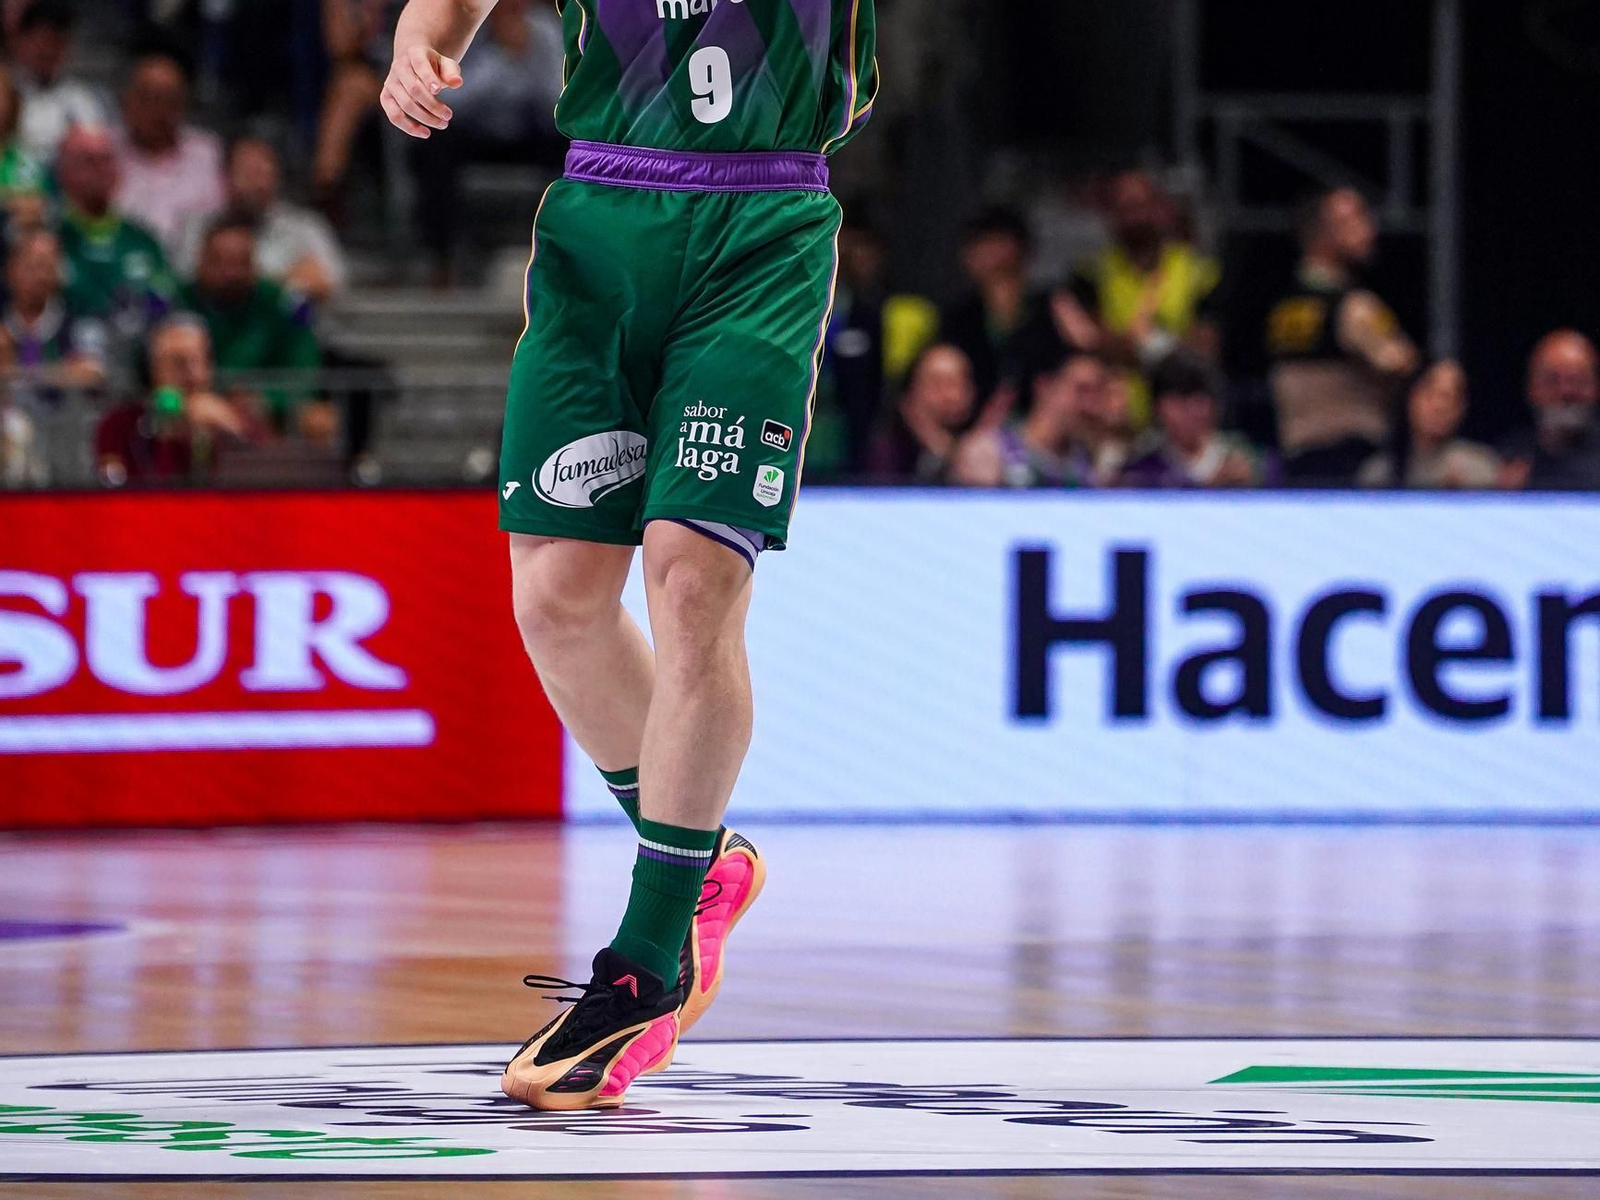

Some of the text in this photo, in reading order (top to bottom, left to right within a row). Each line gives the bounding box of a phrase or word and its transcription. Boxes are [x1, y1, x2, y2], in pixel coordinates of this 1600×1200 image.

[688, 45, 733, 124] 9
[679, 421, 688, 433] a
[683, 400, 728, 419] sabor
[674, 437, 740, 481] laga
[765, 431, 785, 446] acb
[547, 437, 647, 494] famadesa
[0, 569, 409, 698] SUR
